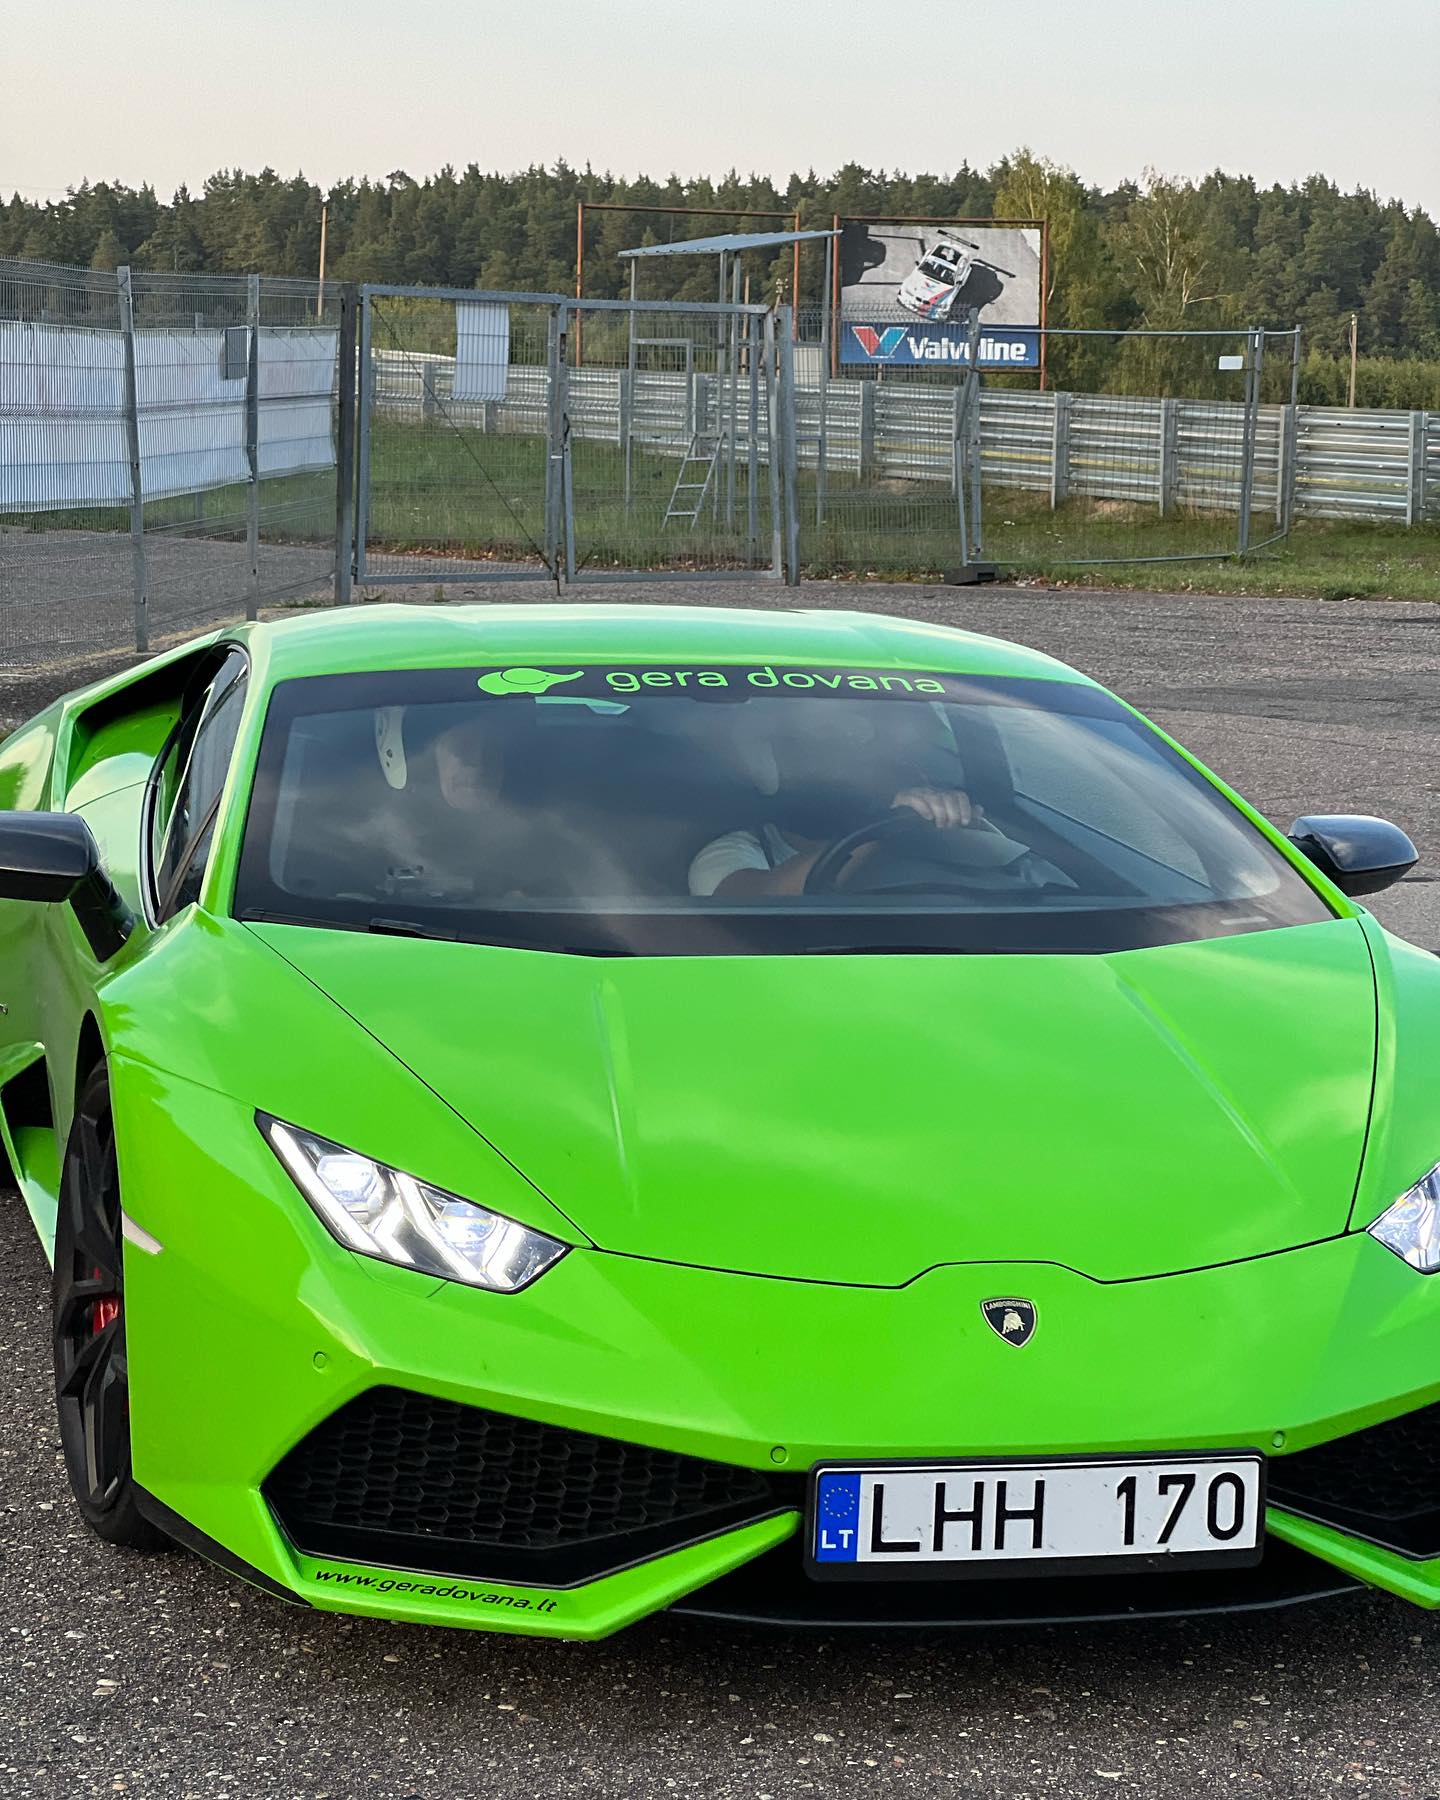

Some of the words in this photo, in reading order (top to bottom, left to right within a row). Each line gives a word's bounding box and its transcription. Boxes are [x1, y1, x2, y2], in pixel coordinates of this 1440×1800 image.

[605, 669, 729, 692] gera
[746, 667, 946, 694] dovana
[871, 1480, 1045, 1552] LHH
[1116, 1471, 1246, 1546] 170
[821, 1530, 853, 1550] LT
[315, 1569, 559, 1613] www.geradovana.lt
